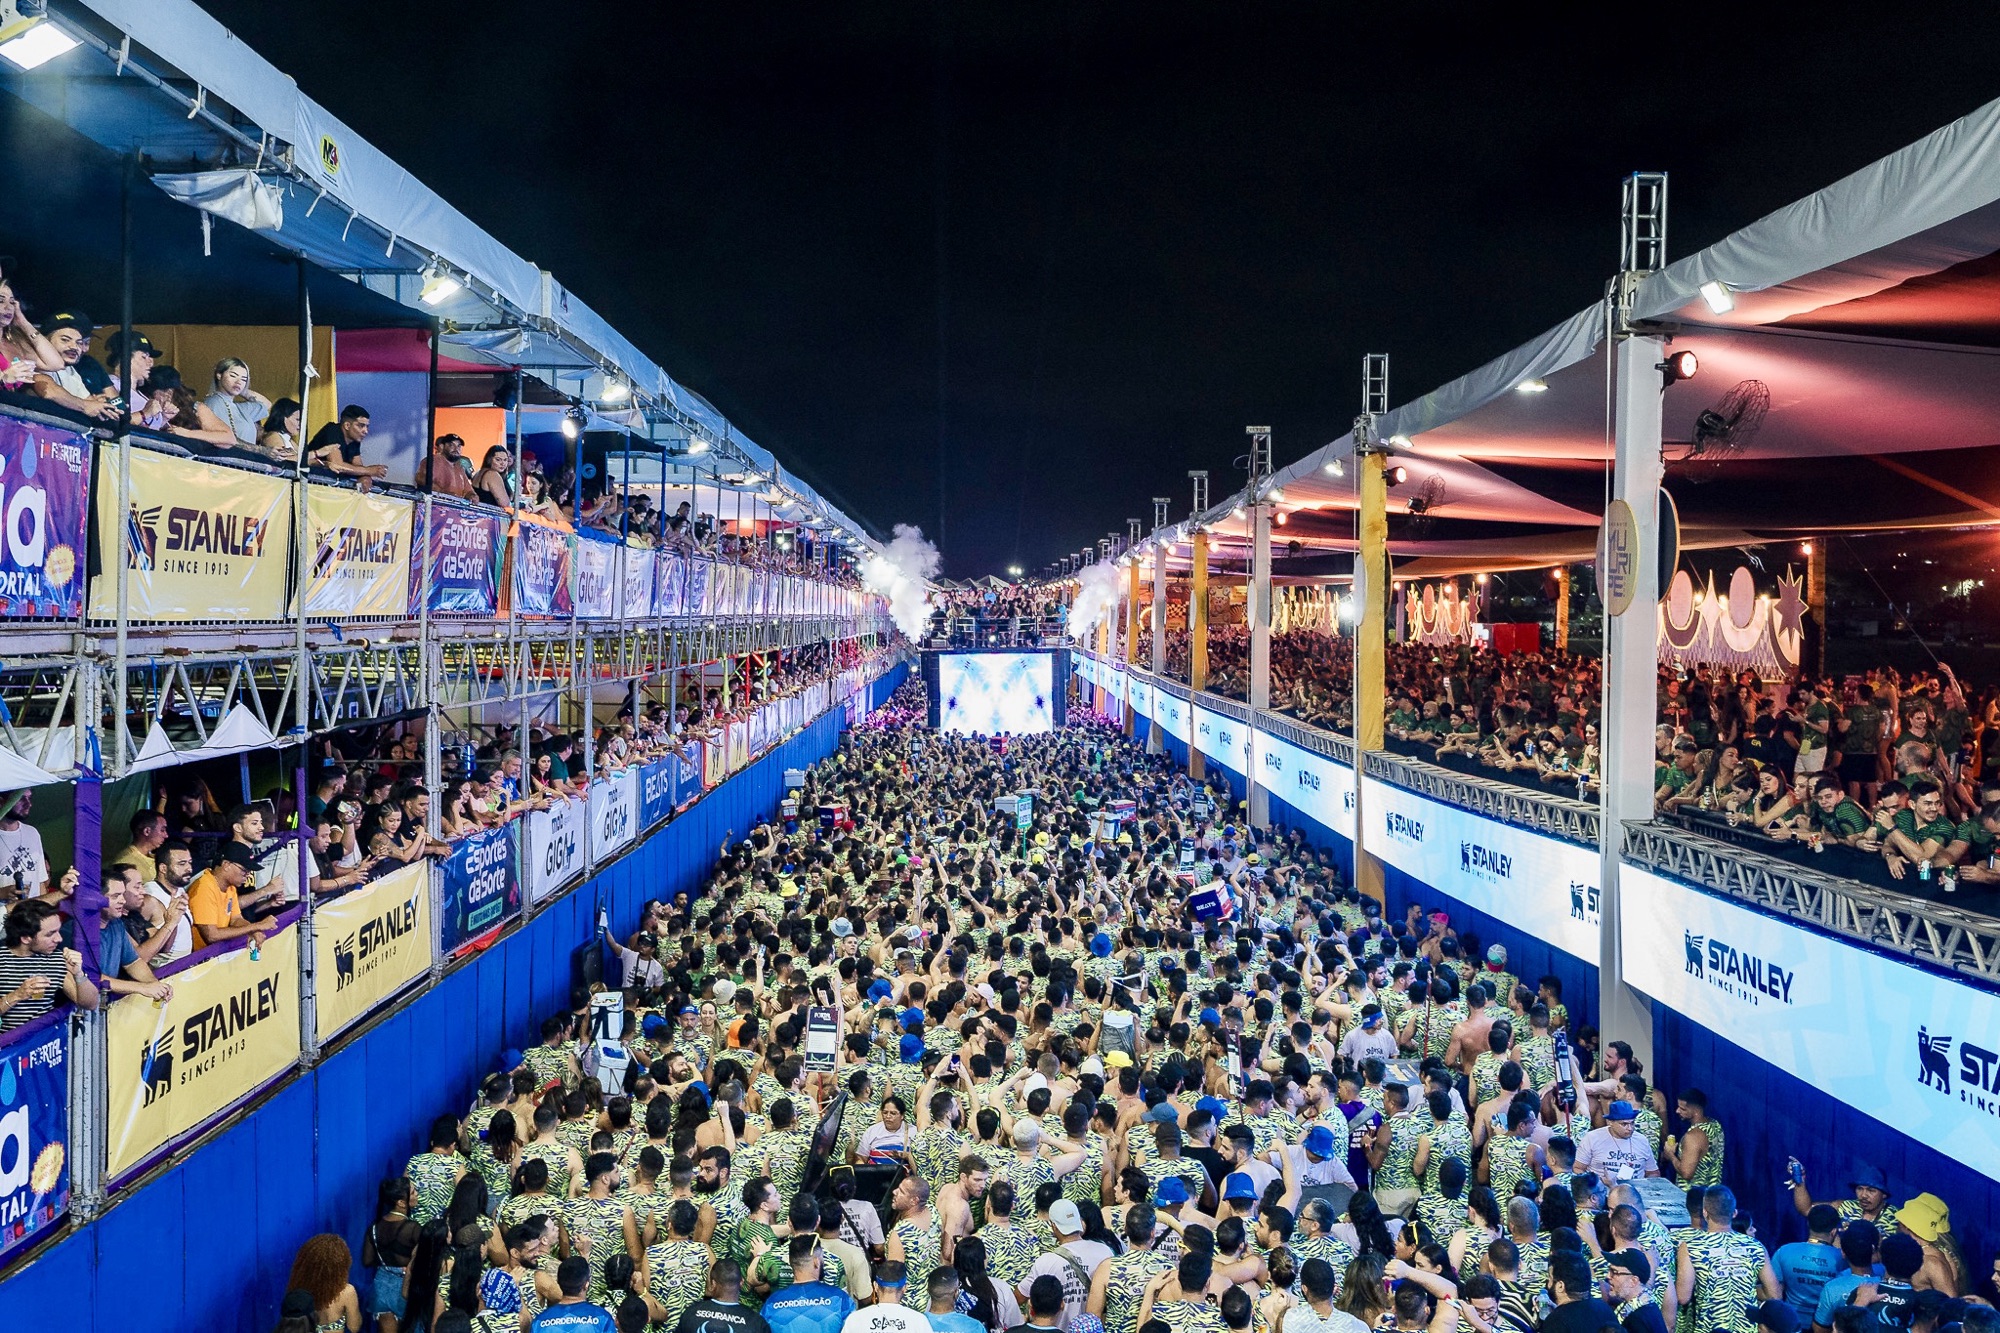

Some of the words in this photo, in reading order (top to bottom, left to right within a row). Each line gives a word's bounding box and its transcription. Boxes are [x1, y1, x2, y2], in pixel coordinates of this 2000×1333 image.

[166, 507, 268, 557] STANLEY
[337, 527, 399, 564] STANLEY
[441, 518, 487, 554] Esportes
[164, 560, 198, 574] SINCE
[205, 562, 229, 576] 1913
[1395, 813, 1425, 843] STANLEY
[465, 837, 507, 877] Esportes
[1472, 844, 1512, 879] STANLEY
[358, 895, 418, 960] STANLEY
[358, 957, 378, 978] SINCE
[1708, 938, 1794, 1004] STANLEY
[1708, 974, 1733, 994] SINCE
[182, 971, 280, 1062] STANLEY
[181, 1058, 216, 1086] SINCE
[221, 1038, 246, 1063] 1913
[773, 1297, 831, 1310] COORDENAÇÃO
[540, 1315, 600, 1329] COORDENAÇÃO
